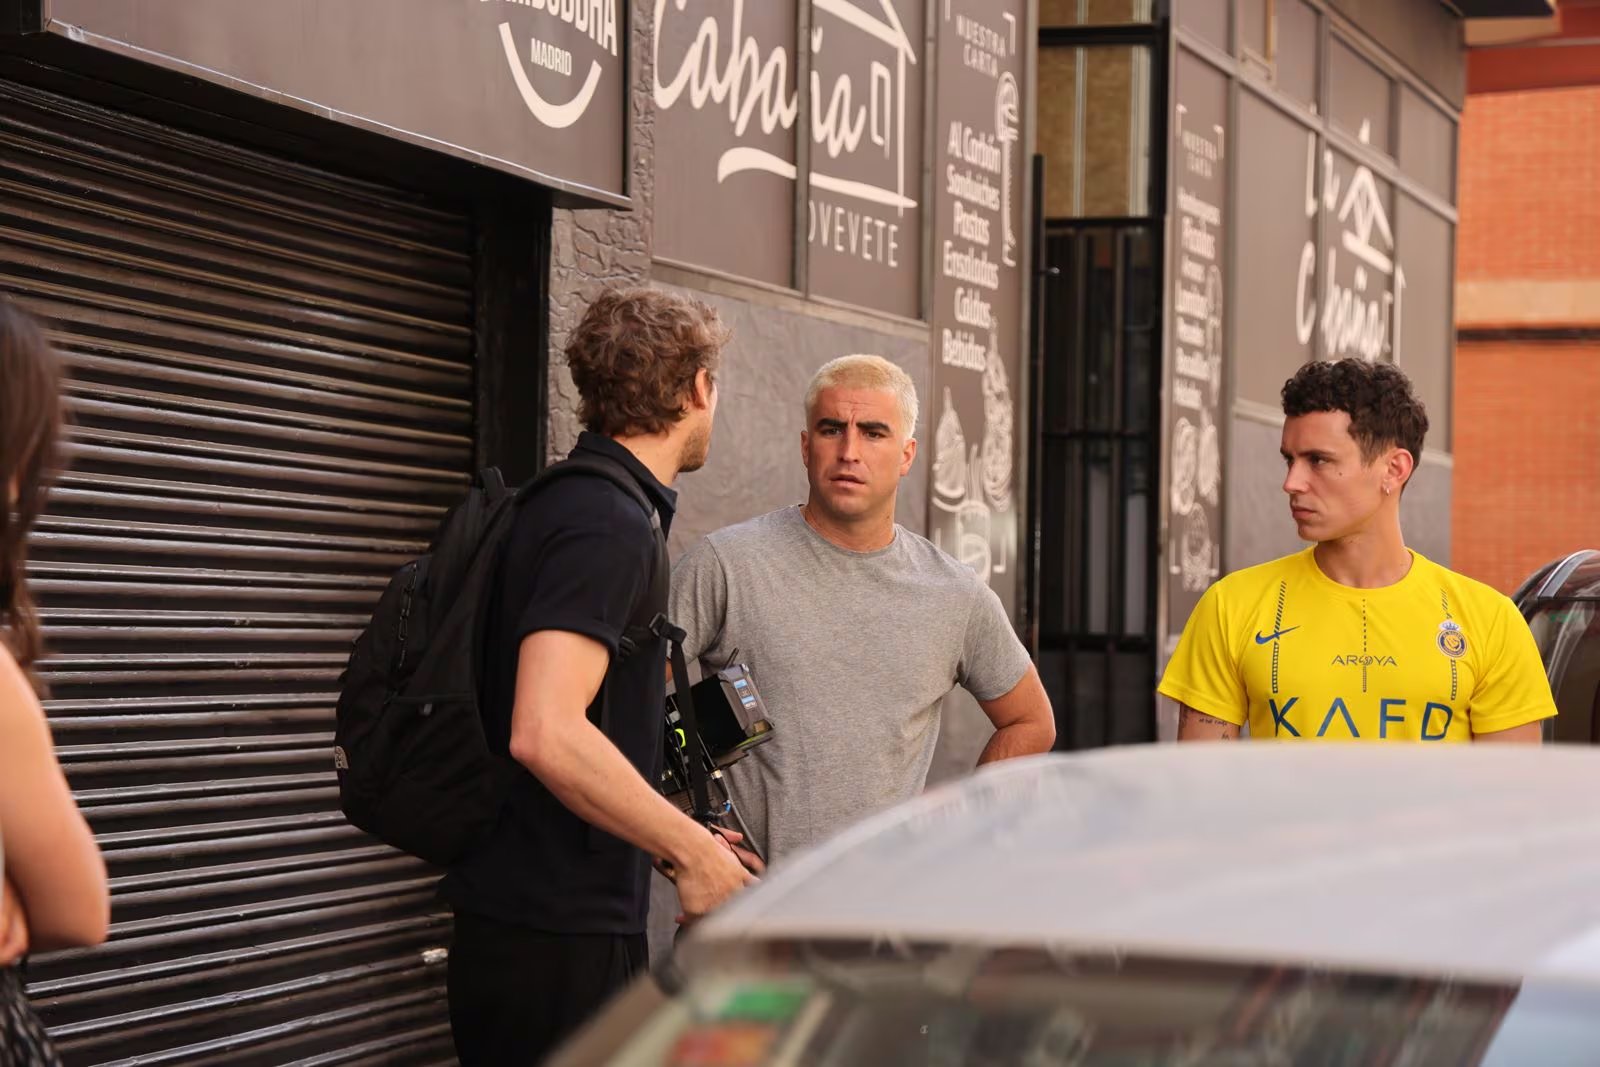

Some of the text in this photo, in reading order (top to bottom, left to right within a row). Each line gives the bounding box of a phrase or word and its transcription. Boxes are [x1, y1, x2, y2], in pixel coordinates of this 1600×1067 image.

[530, 37, 572, 76] MADRID
[947, 120, 963, 159] Al
[1268, 696, 1454, 741] KAFD
